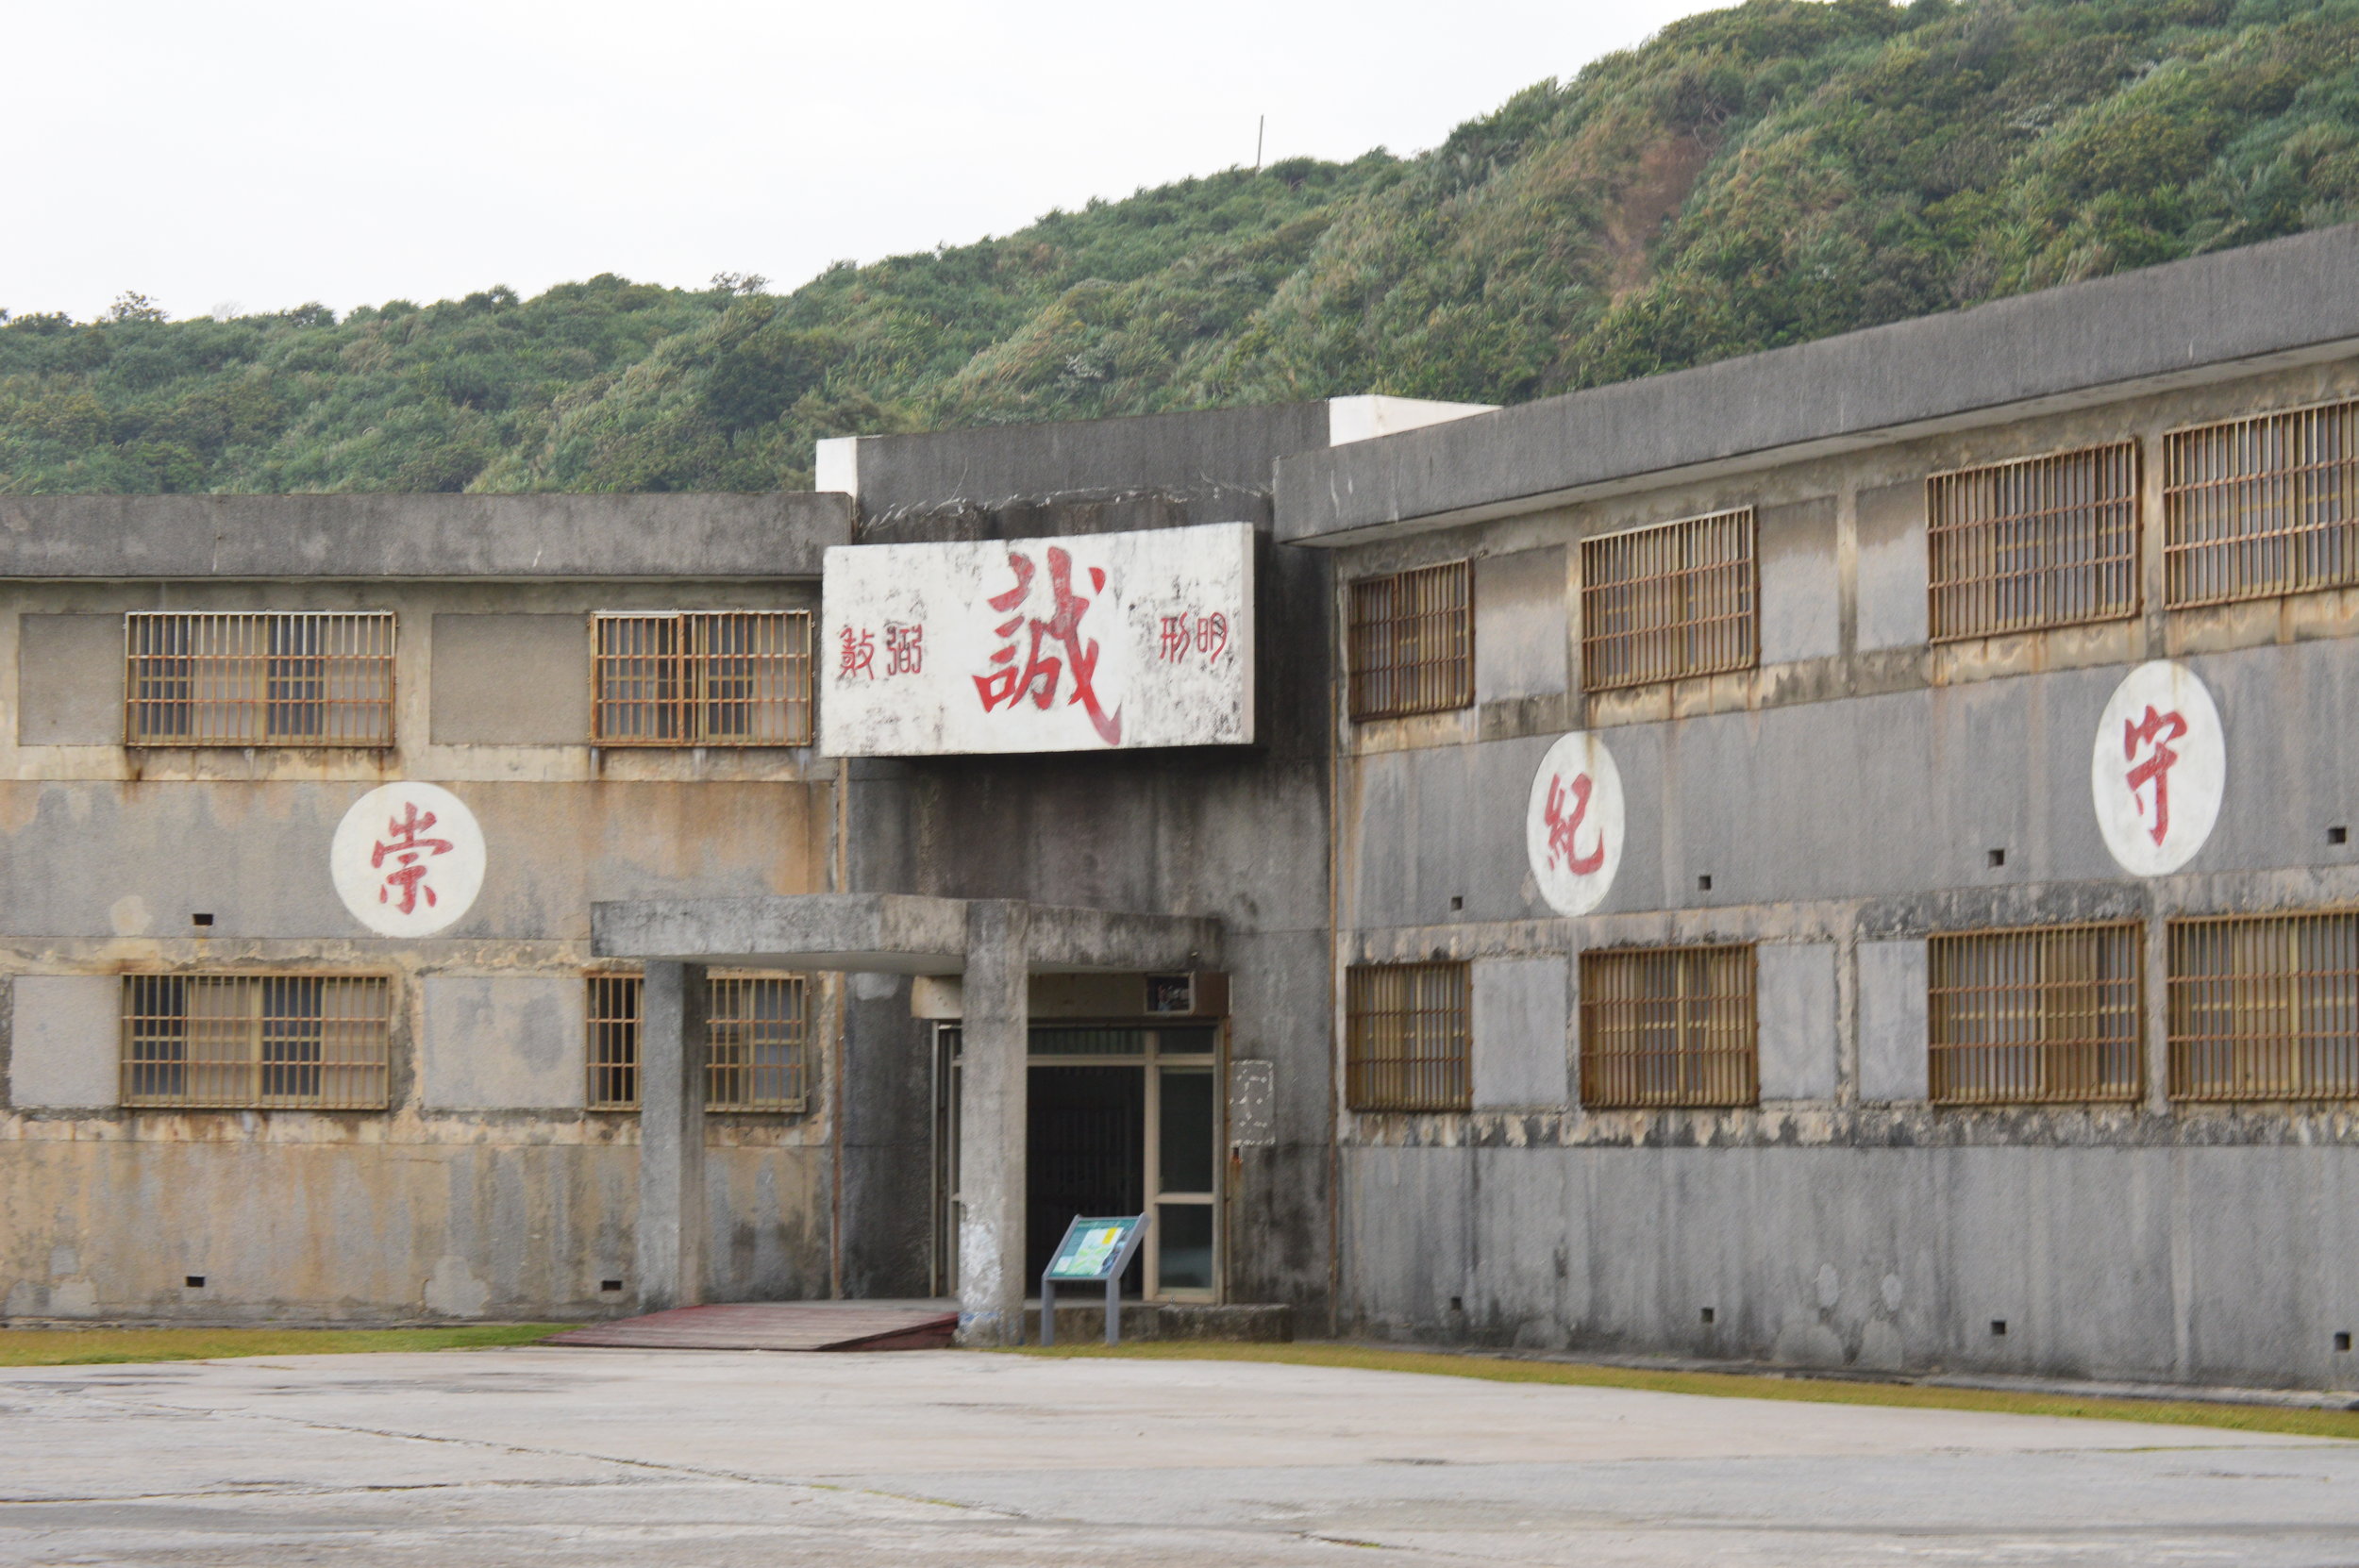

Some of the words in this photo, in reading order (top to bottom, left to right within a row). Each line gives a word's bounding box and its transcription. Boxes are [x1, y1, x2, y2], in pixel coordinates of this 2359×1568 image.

[972, 545, 1121, 745] 誠
[1545, 773, 1605, 876] 紀
[2124, 704, 2188, 847] 守
[371, 802, 454, 915] 崇
